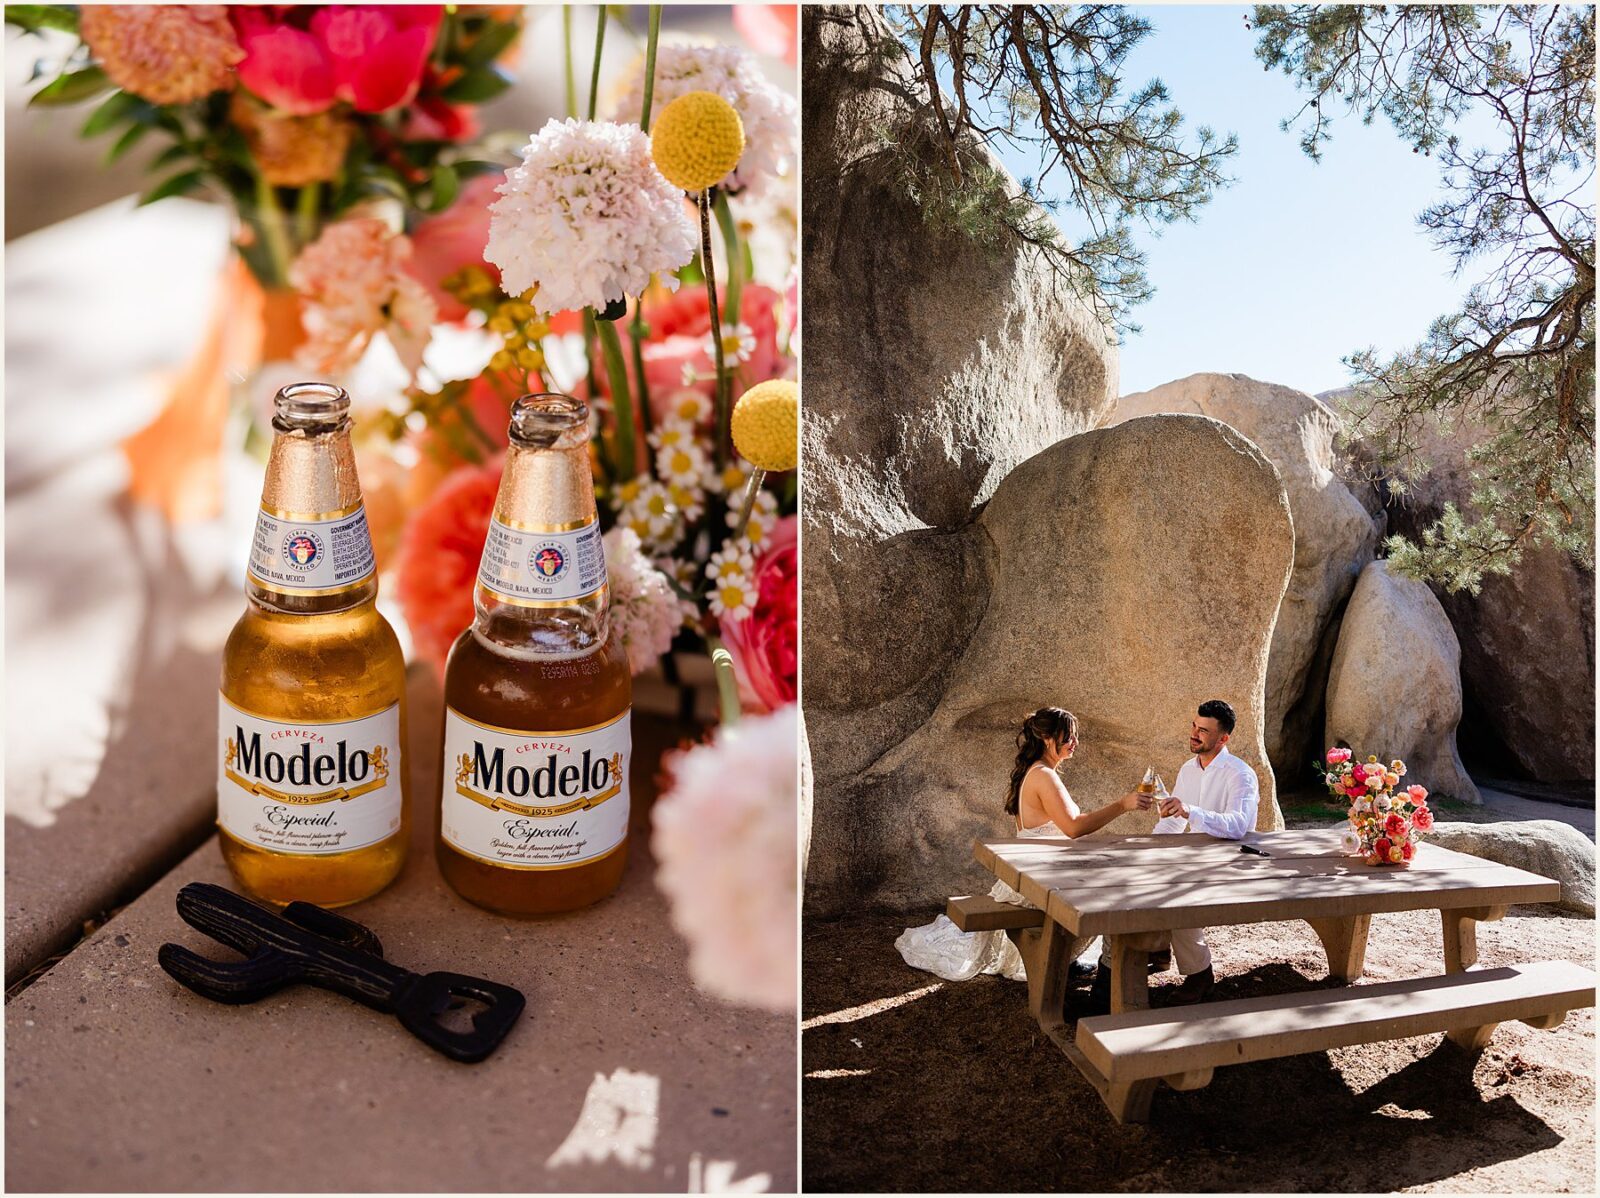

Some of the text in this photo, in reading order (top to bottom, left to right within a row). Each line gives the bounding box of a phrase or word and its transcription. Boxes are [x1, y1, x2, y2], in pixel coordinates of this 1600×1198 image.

[271, 730, 324, 744] CERVEZA
[516, 742, 571, 754] CERVEZA
[236, 725, 369, 786] Modelo
[474, 740, 609, 799] Modelo
[288, 795, 309, 803] 1925
[531, 808, 553, 816] 1925
